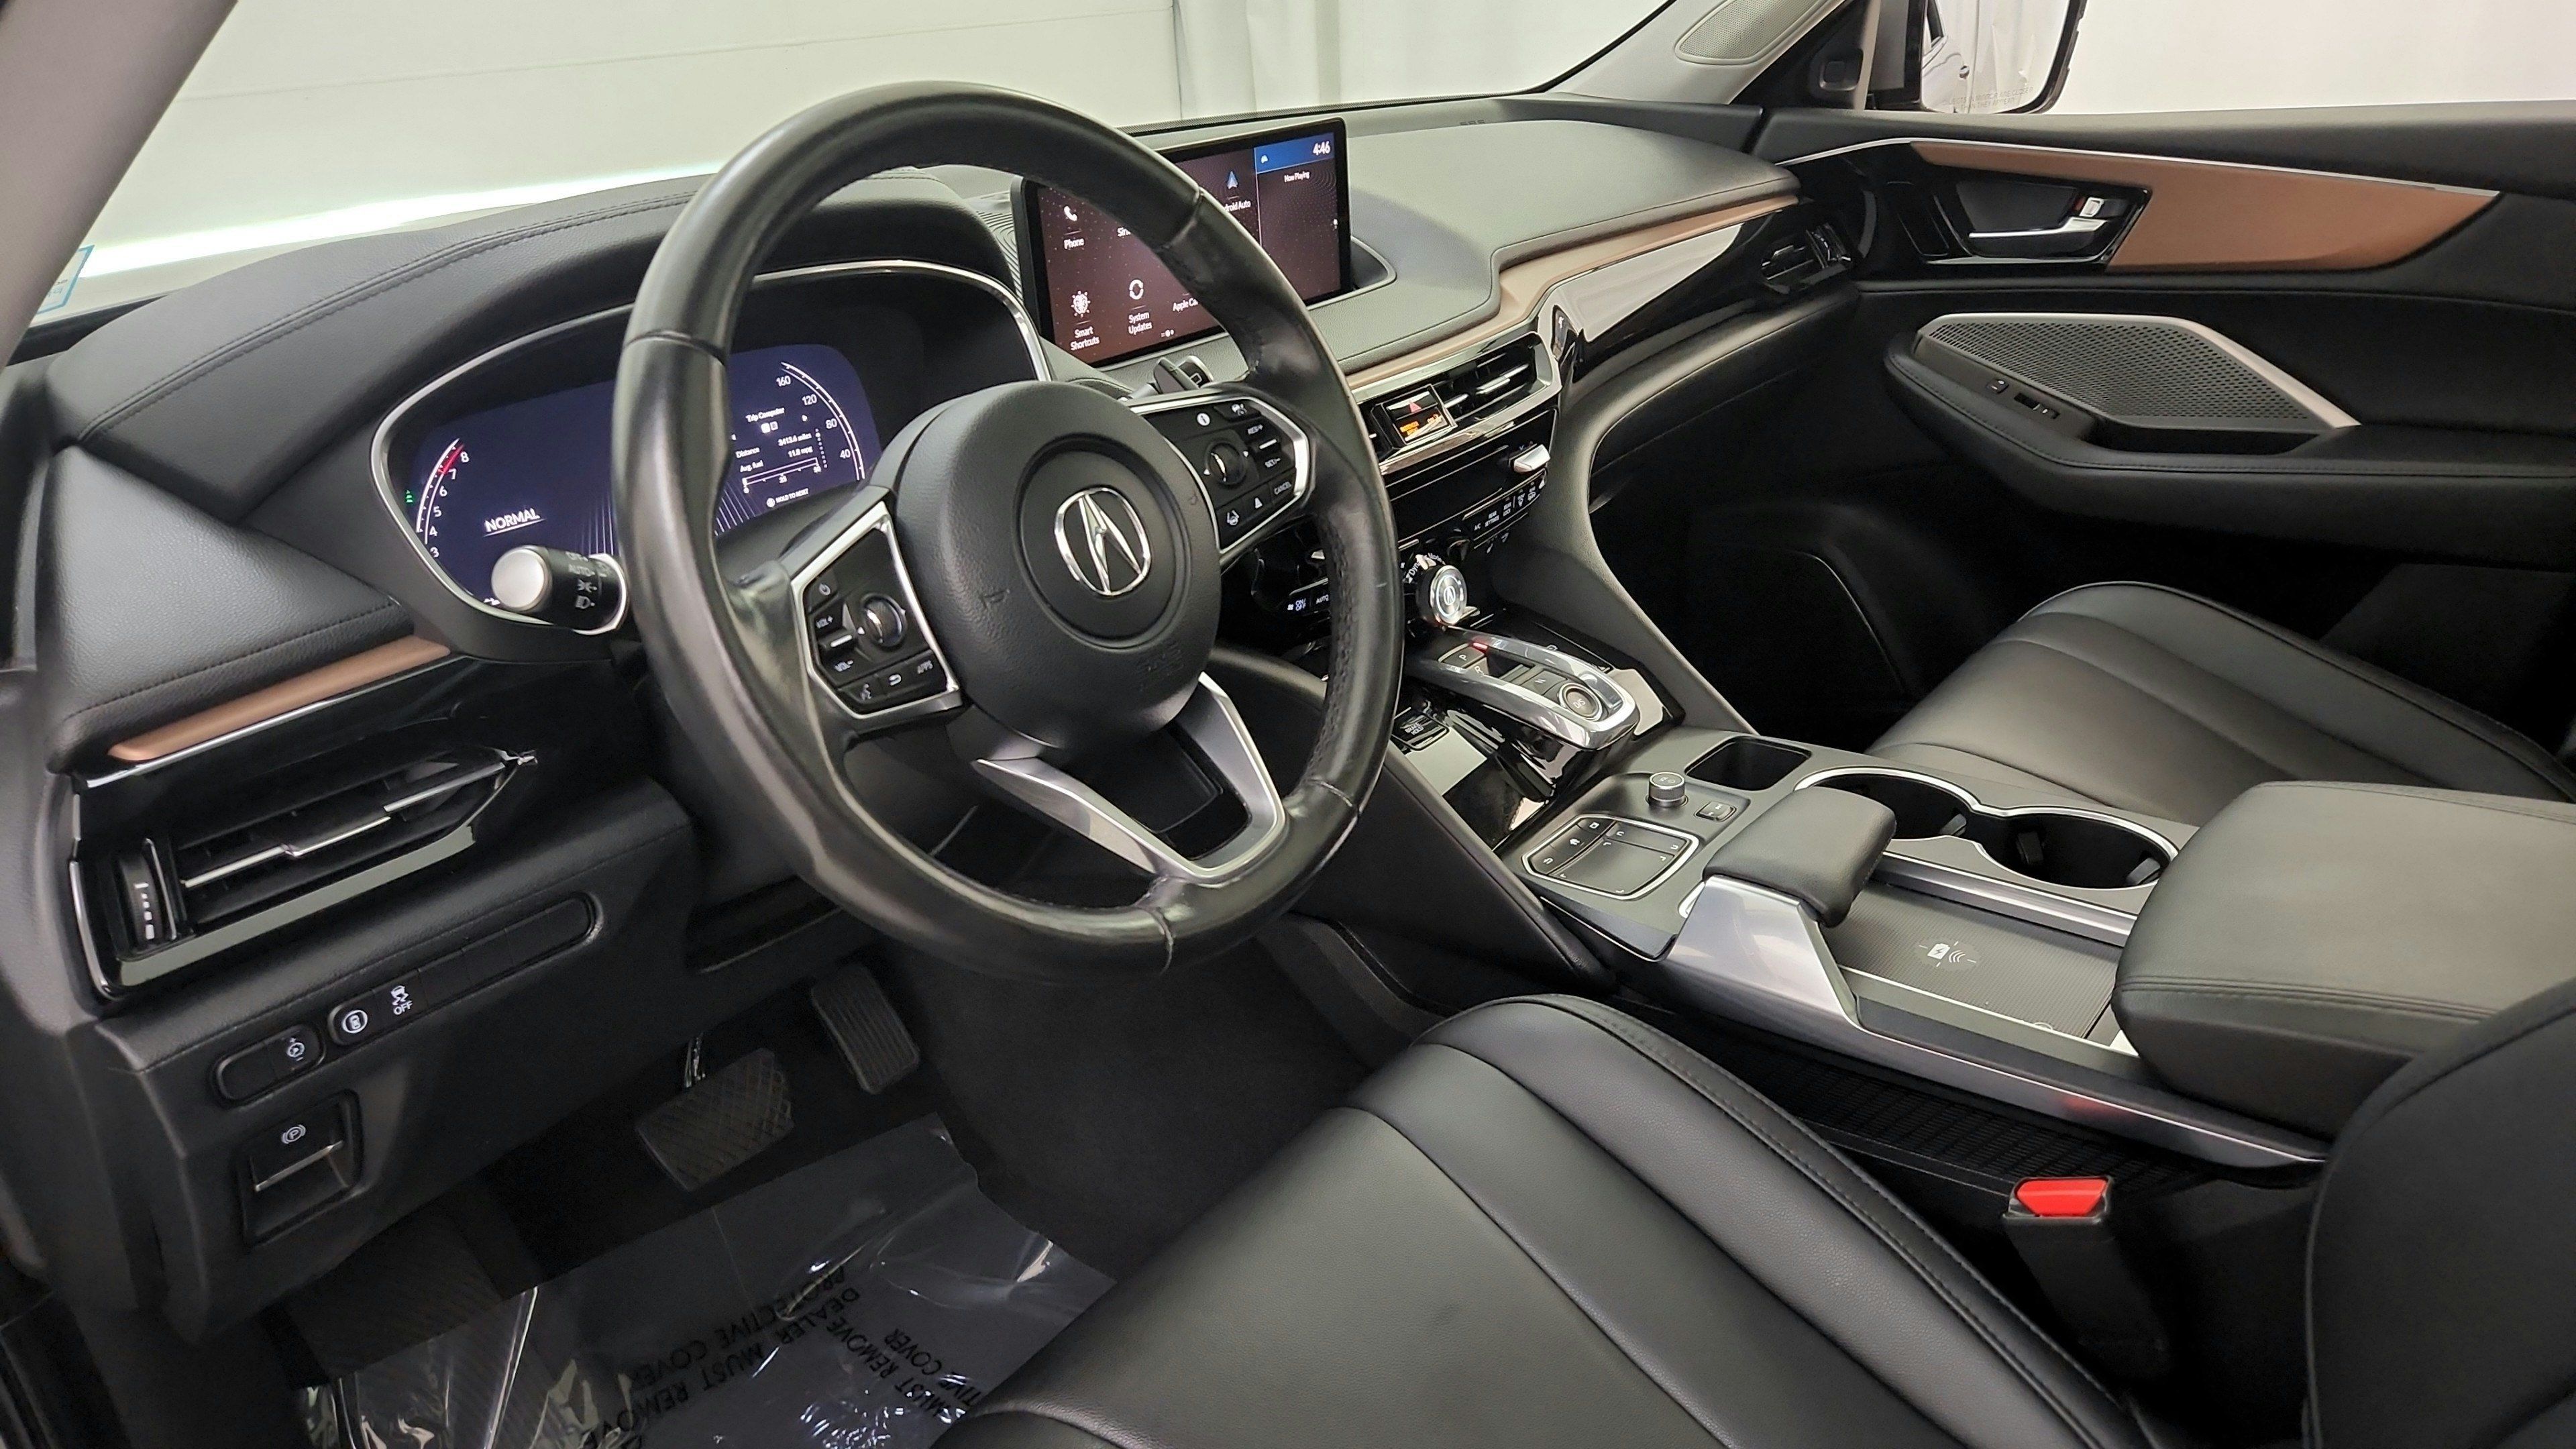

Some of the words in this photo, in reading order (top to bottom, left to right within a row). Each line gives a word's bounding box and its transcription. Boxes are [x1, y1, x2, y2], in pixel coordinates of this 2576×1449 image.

[1312, 141, 1330, 156] 4:46
[1284, 174, 1295, 183] Now
[1295, 171, 1310, 182] Playing
[1224, 203, 1238, 212] droid
[1238, 200, 1251, 209] Auto
[1064, 238, 1085, 250] Phone
[1172, 299, 1189, 312] Apple
[1128, 312, 1150, 324] System
[1075, 326, 1094, 339] Smart
[1128, 322, 1152, 335] Updates
[1070, 336, 1100, 351] Shortcuts
[776, 375, 791, 386] 160
[802, 394, 817, 405] 120
[745, 414, 759, 423] Trip
[758, 407, 785, 419] Computer
[826, 418, 837, 429] 80
[460, 451, 470, 463] 8
[735, 447, 760, 458] Distance
[839, 448, 851, 459] 40
[448, 468, 457, 480] 7
[439, 486, 447, 497] 6
[1274, 482, 1291, 495] CANCEL
[433, 506, 441, 517] 5
[485, 508, 540, 533] NORMAL
[429, 526, 438, 537] 4
[430, 547, 439, 558] 3
[1316, 594, 1329, 604] AUTO
[1474, 665, 1485, 676] R
[1574, 697, 1585, 708] D/S
[393, 1000, 413, 1016] OFF
[774, 1288, 860, 1344] DEALER
[826, 1316, 900, 1379] REMOVE
[884, 1328, 942, 1375] COVER
[703, 1342, 764, 1391] MUST
[938, 1371, 982, 1407] TIVE
[894, 1377, 951, 1417] MUST
